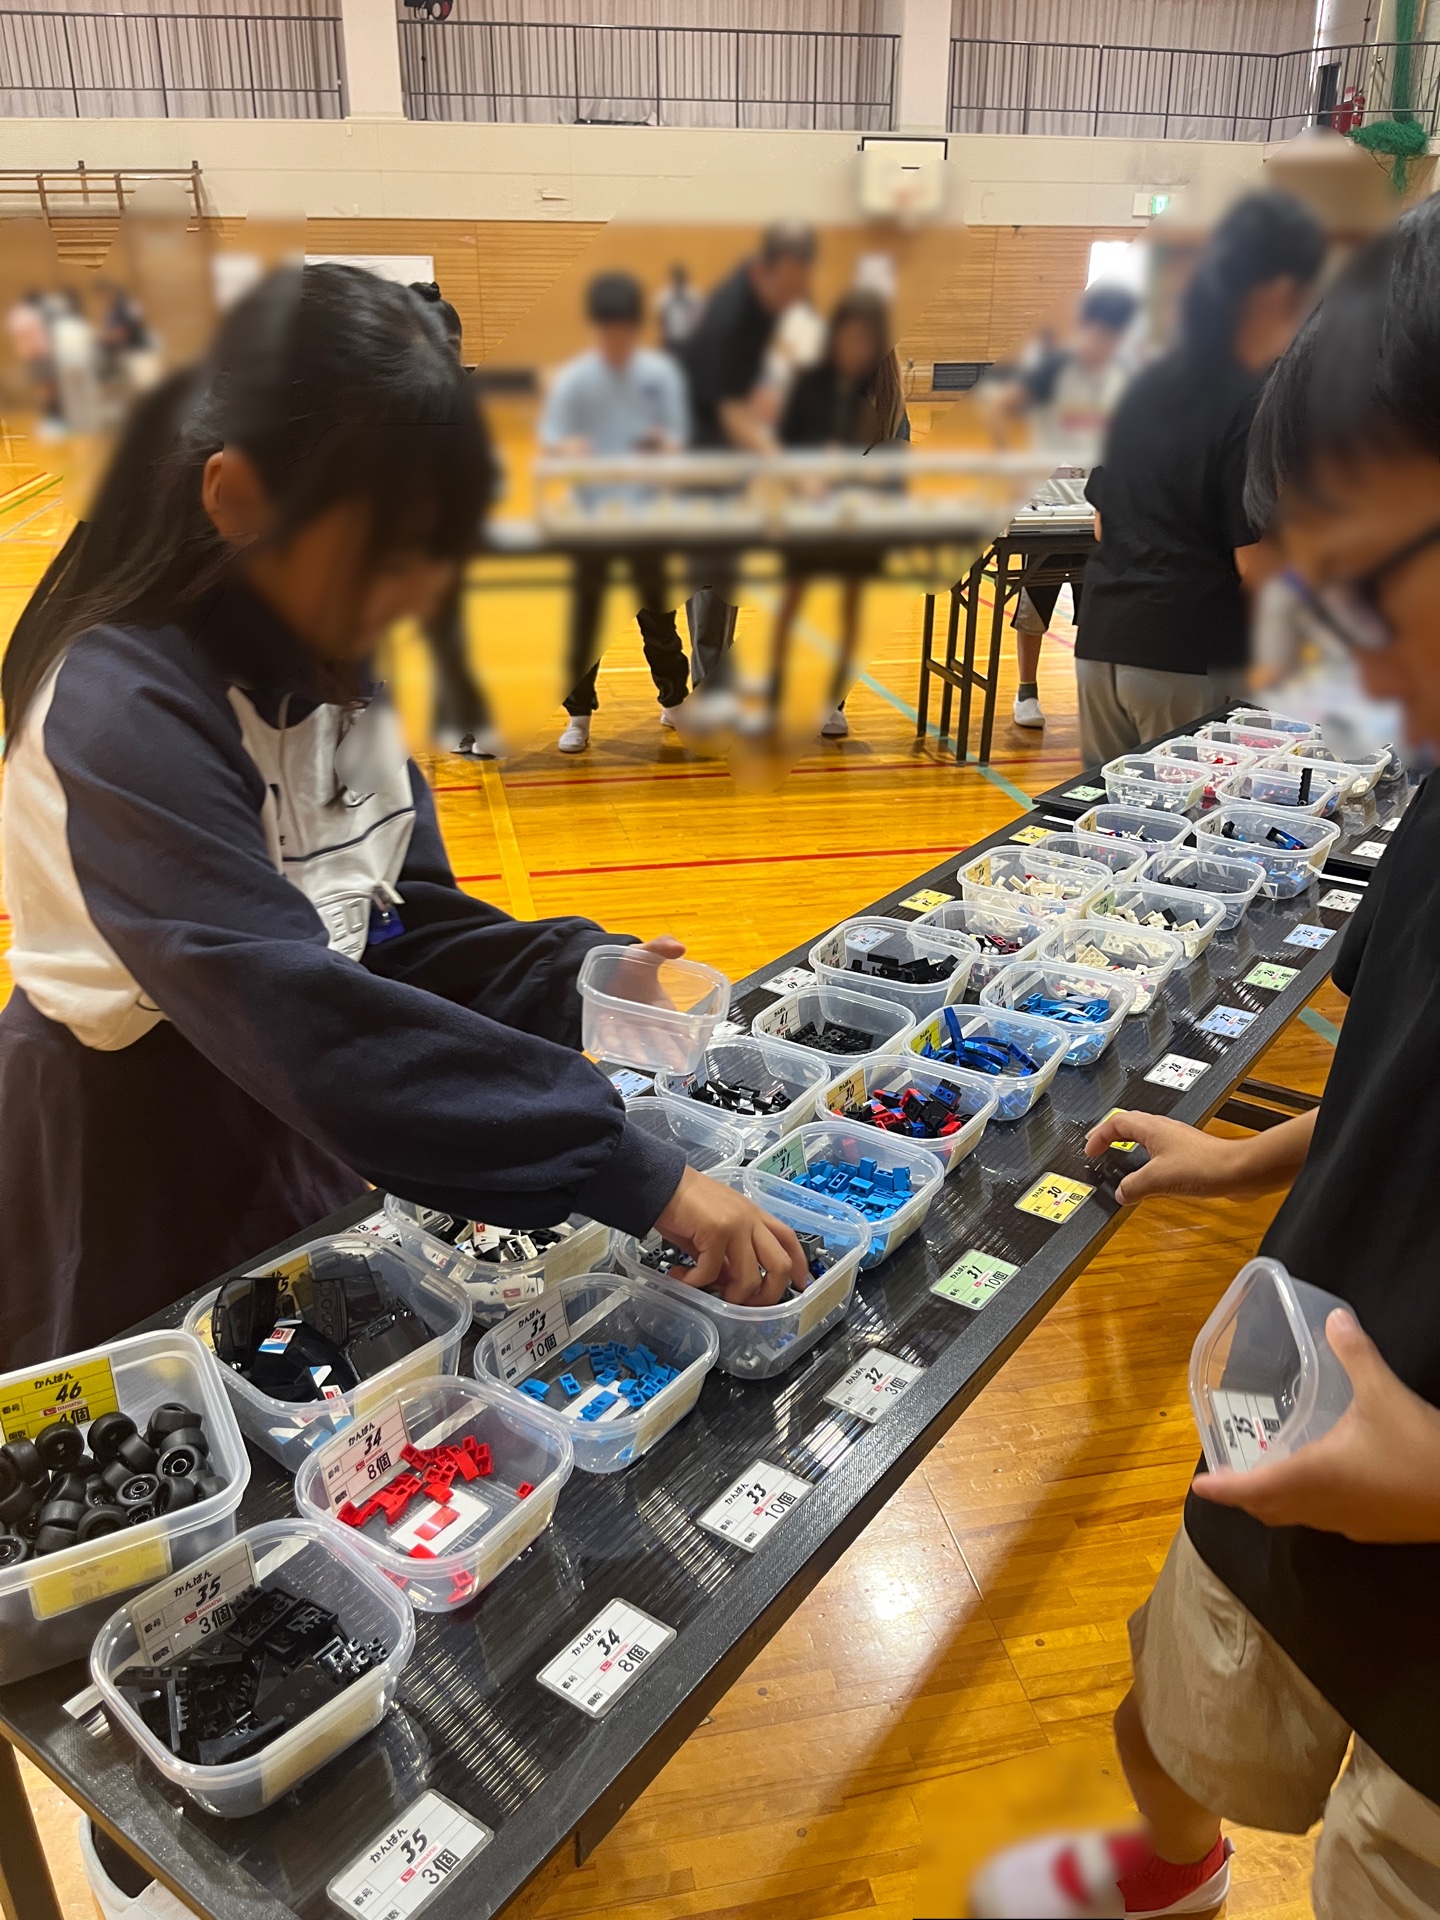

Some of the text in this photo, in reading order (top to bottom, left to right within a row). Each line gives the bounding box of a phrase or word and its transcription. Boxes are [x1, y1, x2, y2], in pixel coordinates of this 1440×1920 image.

[1047, 1186, 1062, 1198] 30
[967, 1265, 983, 1280] 31
[518, 1308, 541, 1329] かんばん
[531, 1313, 546, 1338] 33
[530, 1333, 557, 1362] 10個
[34, 1371, 74, 1390] かんばん
[845, 1366, 866, 1386] かんばん
[865, 1367, 883, 1385] 32
[884, 1377, 909, 1395] 3個
[56, 1381, 82, 1403] 46
[348, 1422, 376, 1447] かんばん
[364, 1426, 382, 1456] 34
[367, 1451, 392, 1480] 8個
[724, 1482, 749, 1506] かんばん
[746, 1483, 767, 1505] 33
[765, 1491, 798, 1520] 10個
[174, 1570, 212, 1597] かんばん
[195, 1575, 222, 1608] 35
[199, 1602, 232, 1635] 3個
[571, 1628, 602, 1657] かんばん
[597, 1628, 621, 1657] 34
[618, 1644, 650, 1673] 8個
[369, 1828, 408, 1864] かんばん
[400, 1828, 428, 1865] 35
[413, 1845, 438, 1871] DAIHATSU
[421, 1847, 461, 1885] 3個
